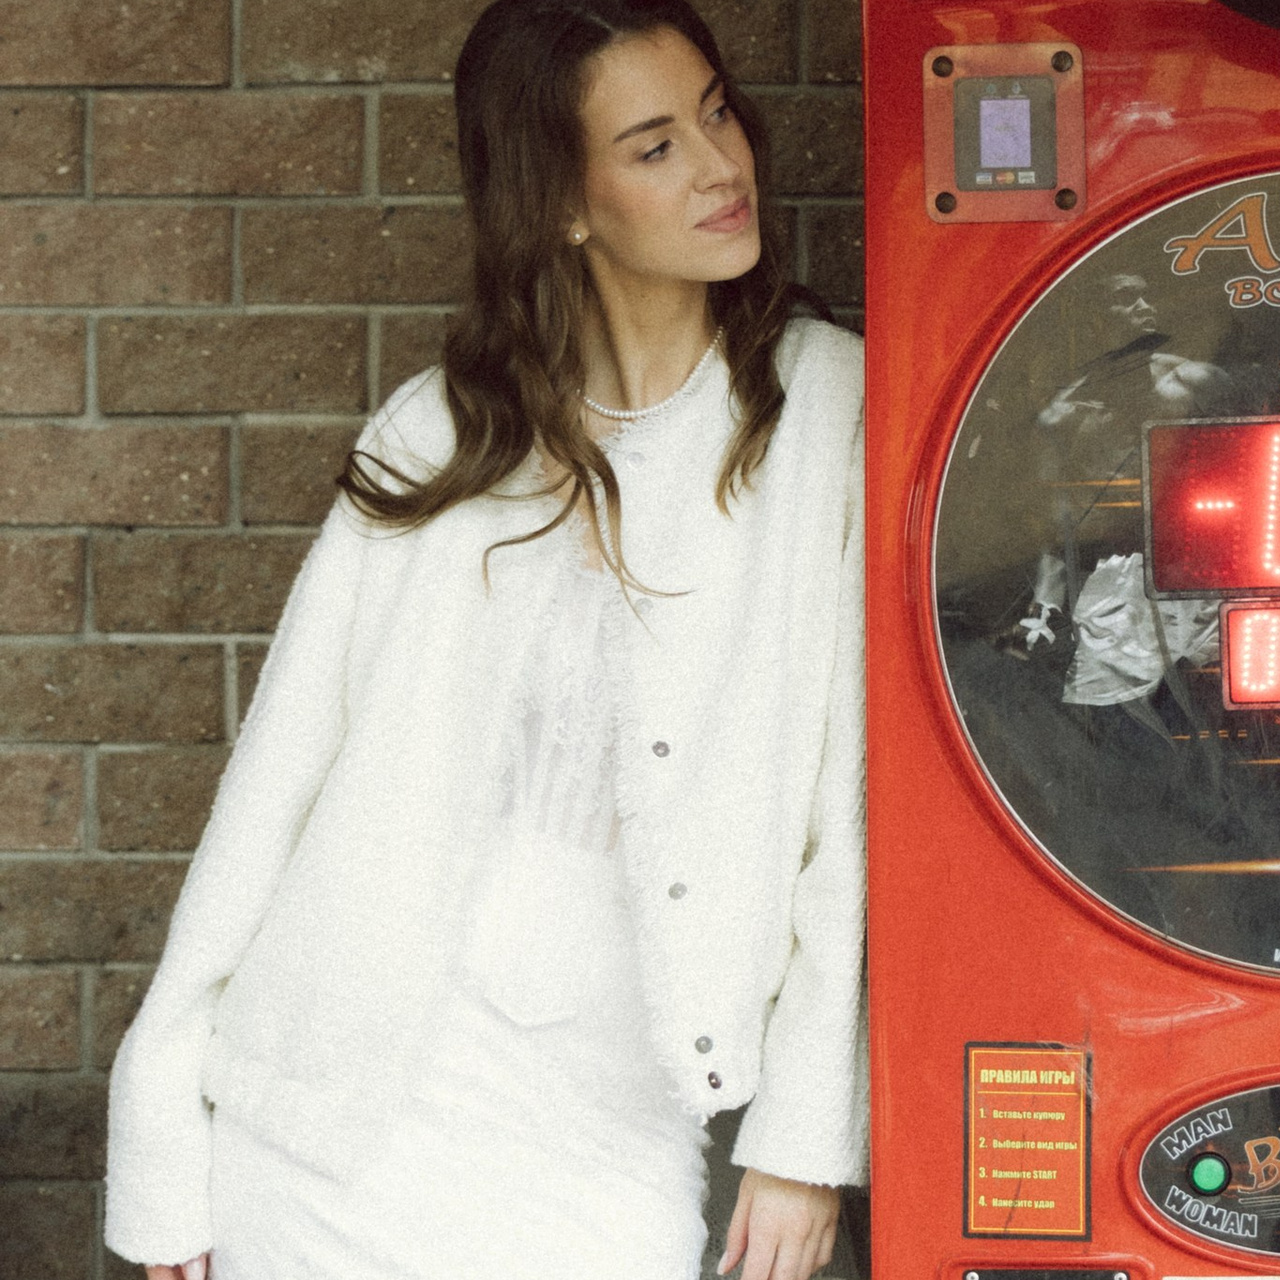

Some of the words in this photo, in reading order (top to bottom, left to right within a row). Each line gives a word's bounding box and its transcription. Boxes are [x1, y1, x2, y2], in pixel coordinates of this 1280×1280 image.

[980, 1068, 1038, 1084] ПРАВИЛА
[1039, 1070, 1076, 1085] ИГРЫ
[979, 1107, 987, 1119] 1.
[992, 1109, 1033, 1120] Вставьте
[1160, 1108, 1233, 1159] MAN
[978, 1136, 988, 1149] 2.
[1036, 1141, 1054, 1151] вид
[1055, 1142, 1078, 1151] игры
[978, 1166, 988, 1179] 3.
[991, 1169, 1032, 1180] Нажмите
[1032, 1170, 1058, 1180] START
[978, 1195, 988, 1207] 4.
[1034, 1200, 1055, 1209] удар
[1164, 1186, 1258, 1238] WOMAN
